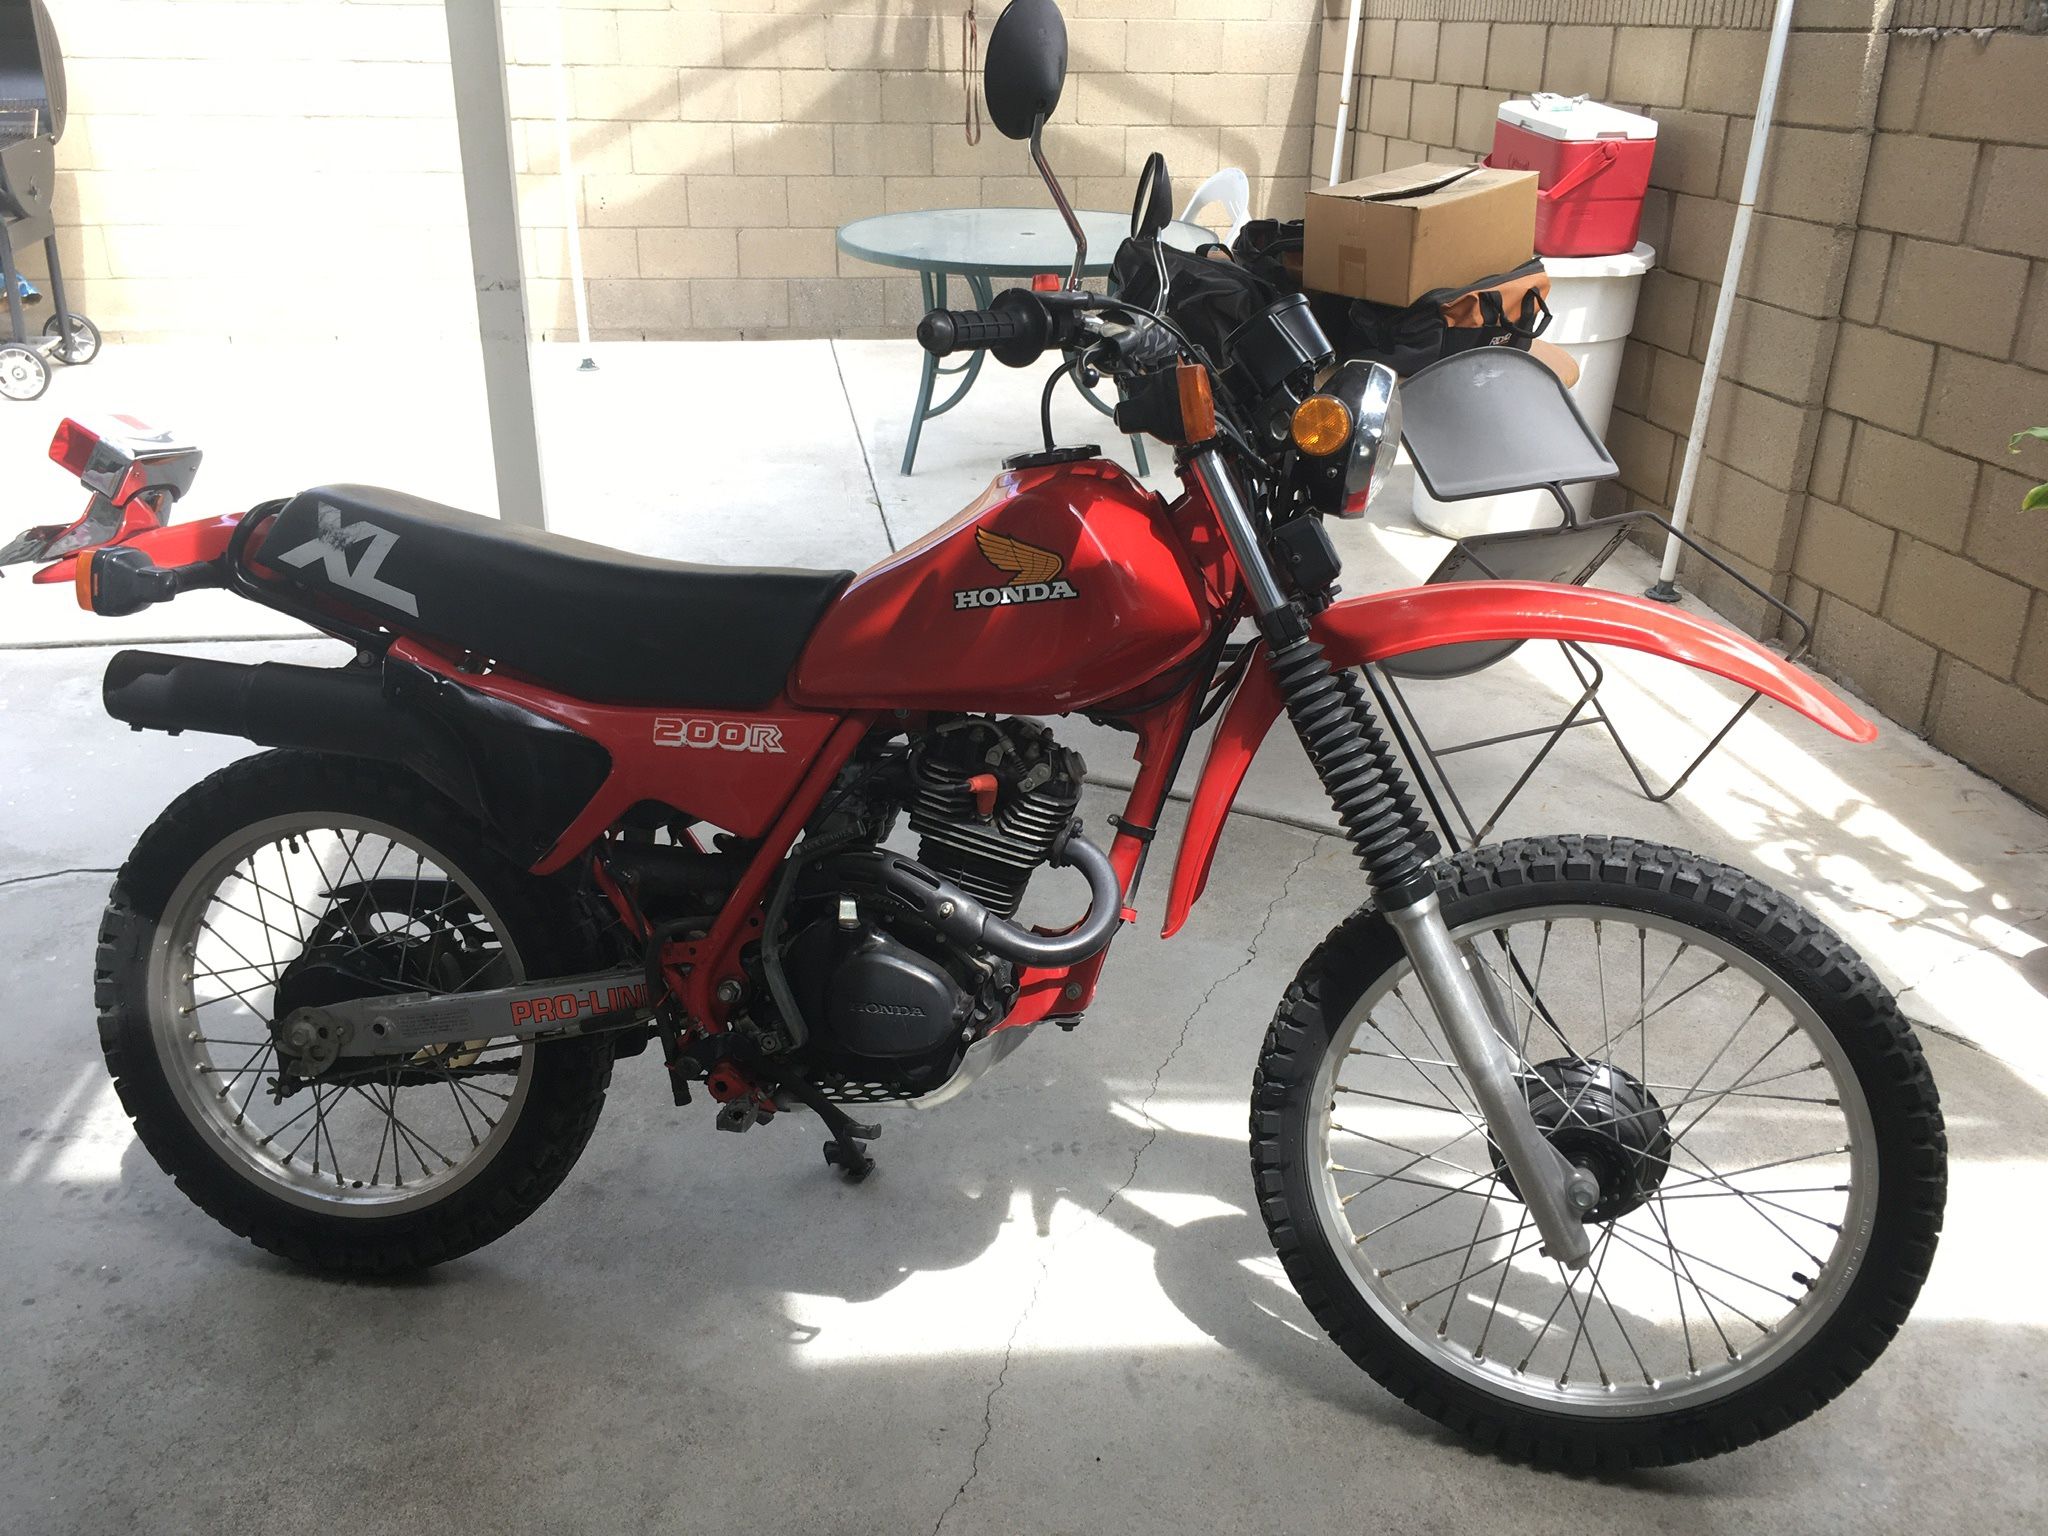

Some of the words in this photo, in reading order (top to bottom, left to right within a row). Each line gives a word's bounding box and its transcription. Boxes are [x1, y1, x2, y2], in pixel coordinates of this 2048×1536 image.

[277, 500, 420, 618] XL
[954, 580, 1077, 609] HONDA
[653, 717, 788, 753] 200R
